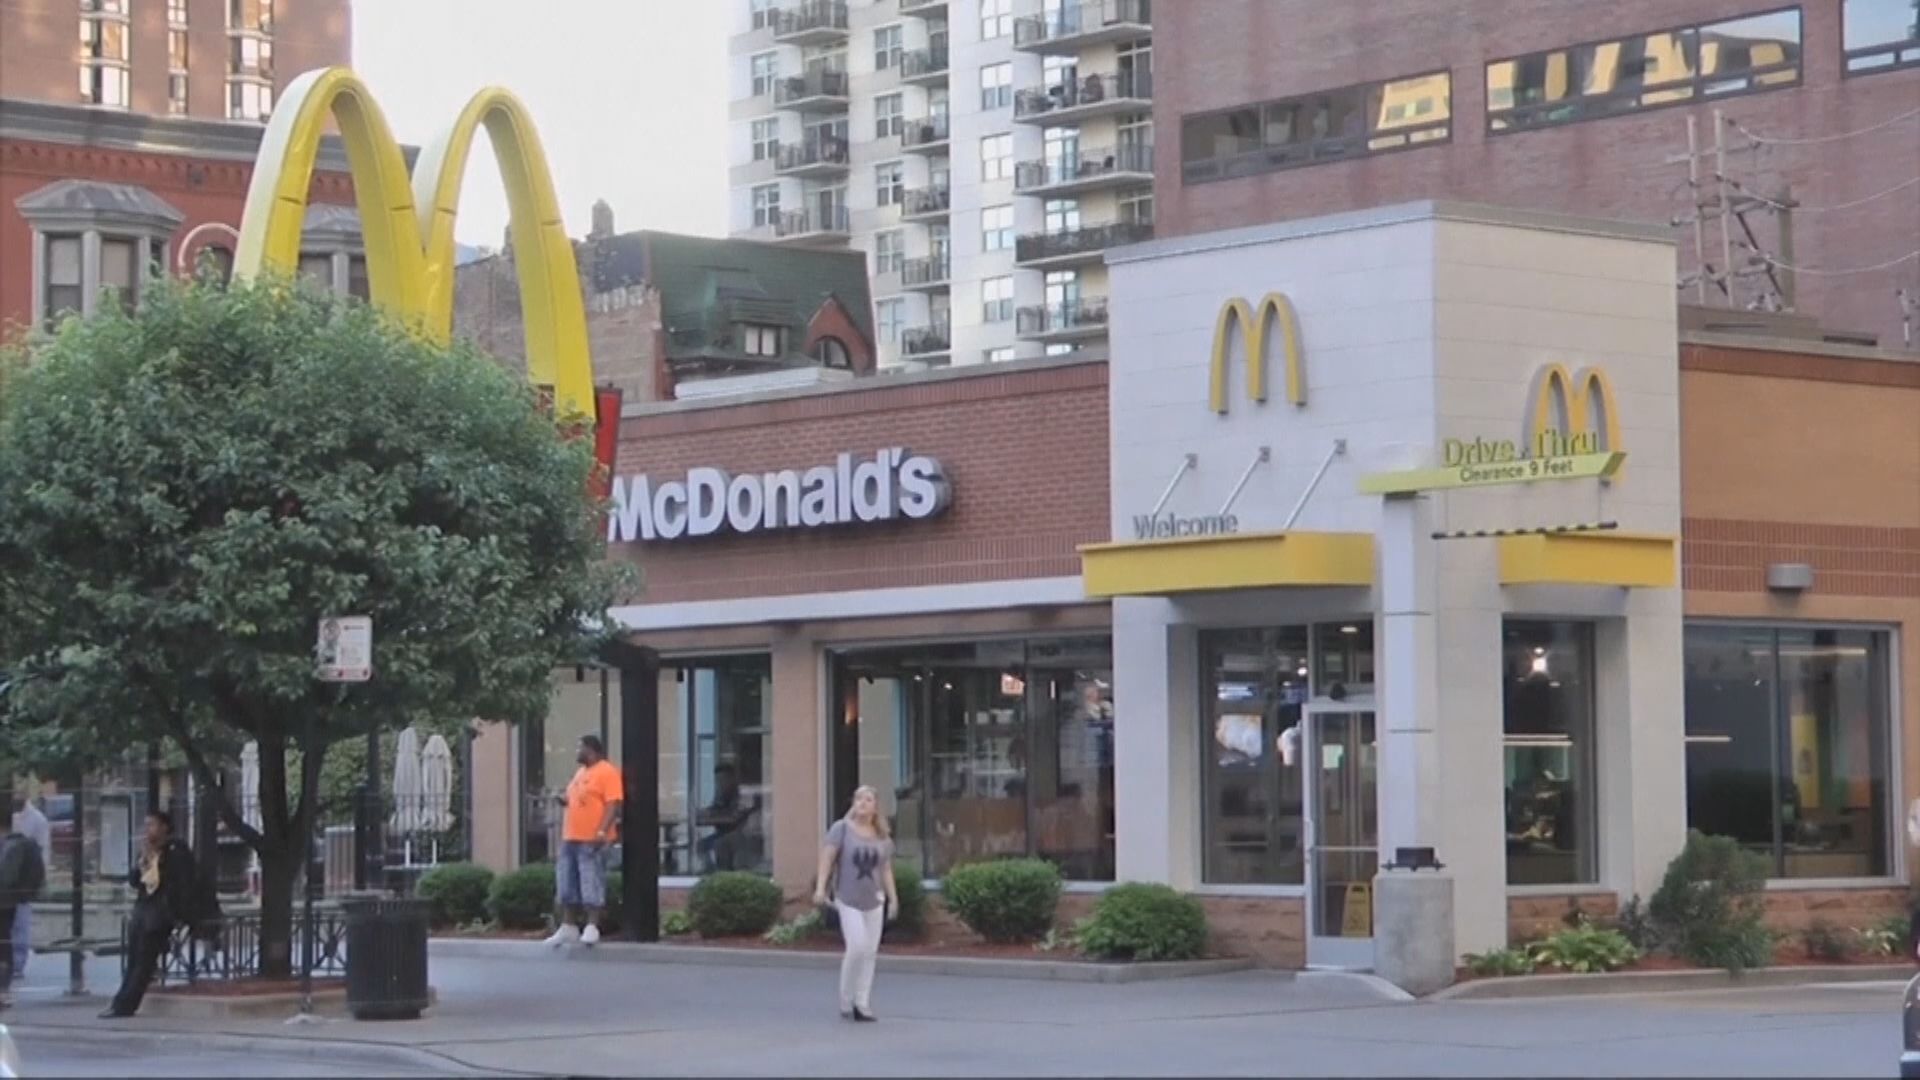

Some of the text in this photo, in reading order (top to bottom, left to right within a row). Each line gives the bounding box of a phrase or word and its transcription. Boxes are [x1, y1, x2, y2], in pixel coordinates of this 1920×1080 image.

[1209, 292, 1308, 415] M
[1443, 437, 1516, 468] Drive
[1460, 459, 1573, 482] Clearance 9 Feet
[608, 447, 942, 543] McDonald's
[1132, 512, 1239, 539] Welcome
